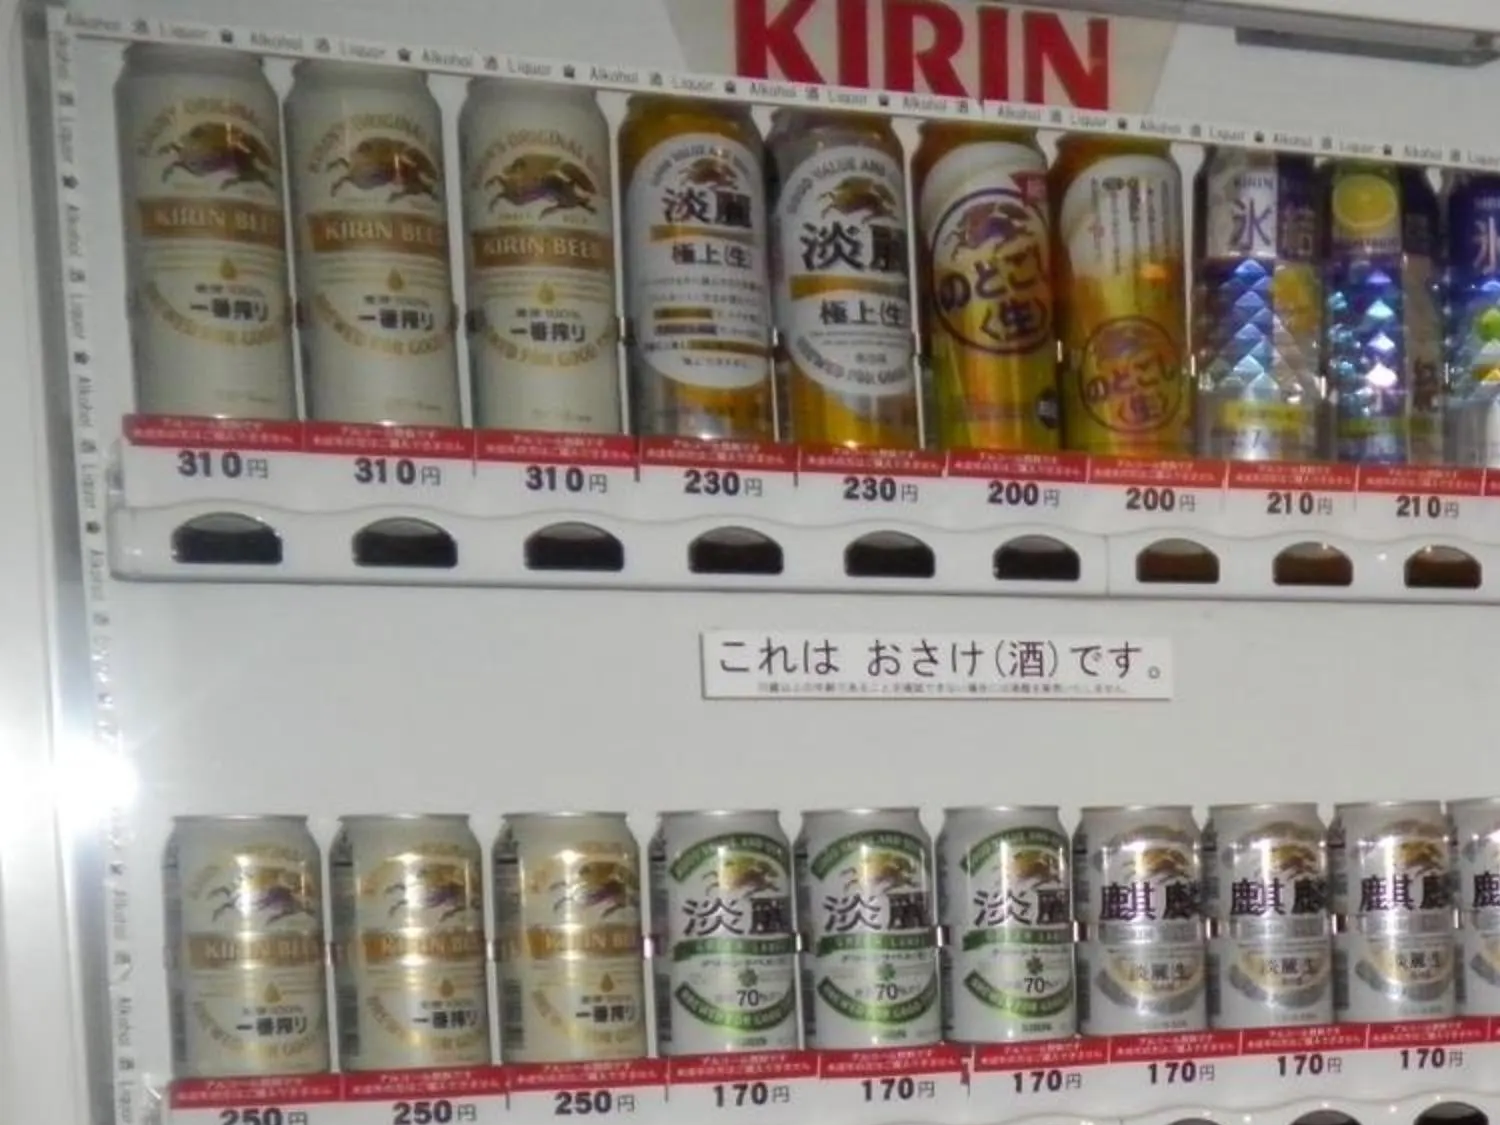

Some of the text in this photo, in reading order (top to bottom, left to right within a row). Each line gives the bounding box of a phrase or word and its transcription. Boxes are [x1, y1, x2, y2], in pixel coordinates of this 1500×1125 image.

[735, 0, 1111, 111] KIRIN
[661, 185, 753, 228] 淡麗
[190, 298, 270, 323] 一番搾り
[358, 308, 435, 332] 一番搾り
[510, 320, 587, 343] 一番搾り
[177, 450, 269, 481] 310円
[353, 457, 441, 487] 310円
[525, 465, 608, 493] 310円
[684, 469, 763, 497] 230円
[843, 476, 919, 503] 230円
[987, 481, 1061, 508] 200円
[1125, 487, 1196, 513] 200円
[1266, 492, 1333, 517] 210円
[1396, 495, 1459, 519] 210円
[719, 637, 1162, 680] これは おさけ(酒)です。
[682, 897, 792, 936] 淡麗
[823, 891, 934, 932] 淡麗
[973, 888, 1071, 927] 淡麗
[236, 1015, 308, 1037] 一番搾り
[412, 1008, 479, 1031] 一番搾り
[575, 1004, 635, 1026] 一番搾り
[1276, 1053, 1343, 1078] 170円
[1400, 1047, 1464, 1071] 170円
[1012, 1069, 1082, 1093] 170円
[1147, 1061, 1216, 1085] 170円
[554, 1090, 636, 1115] 250円
[713, 1082, 791, 1107] 170円
[861, 1077, 936, 1103] 170円
